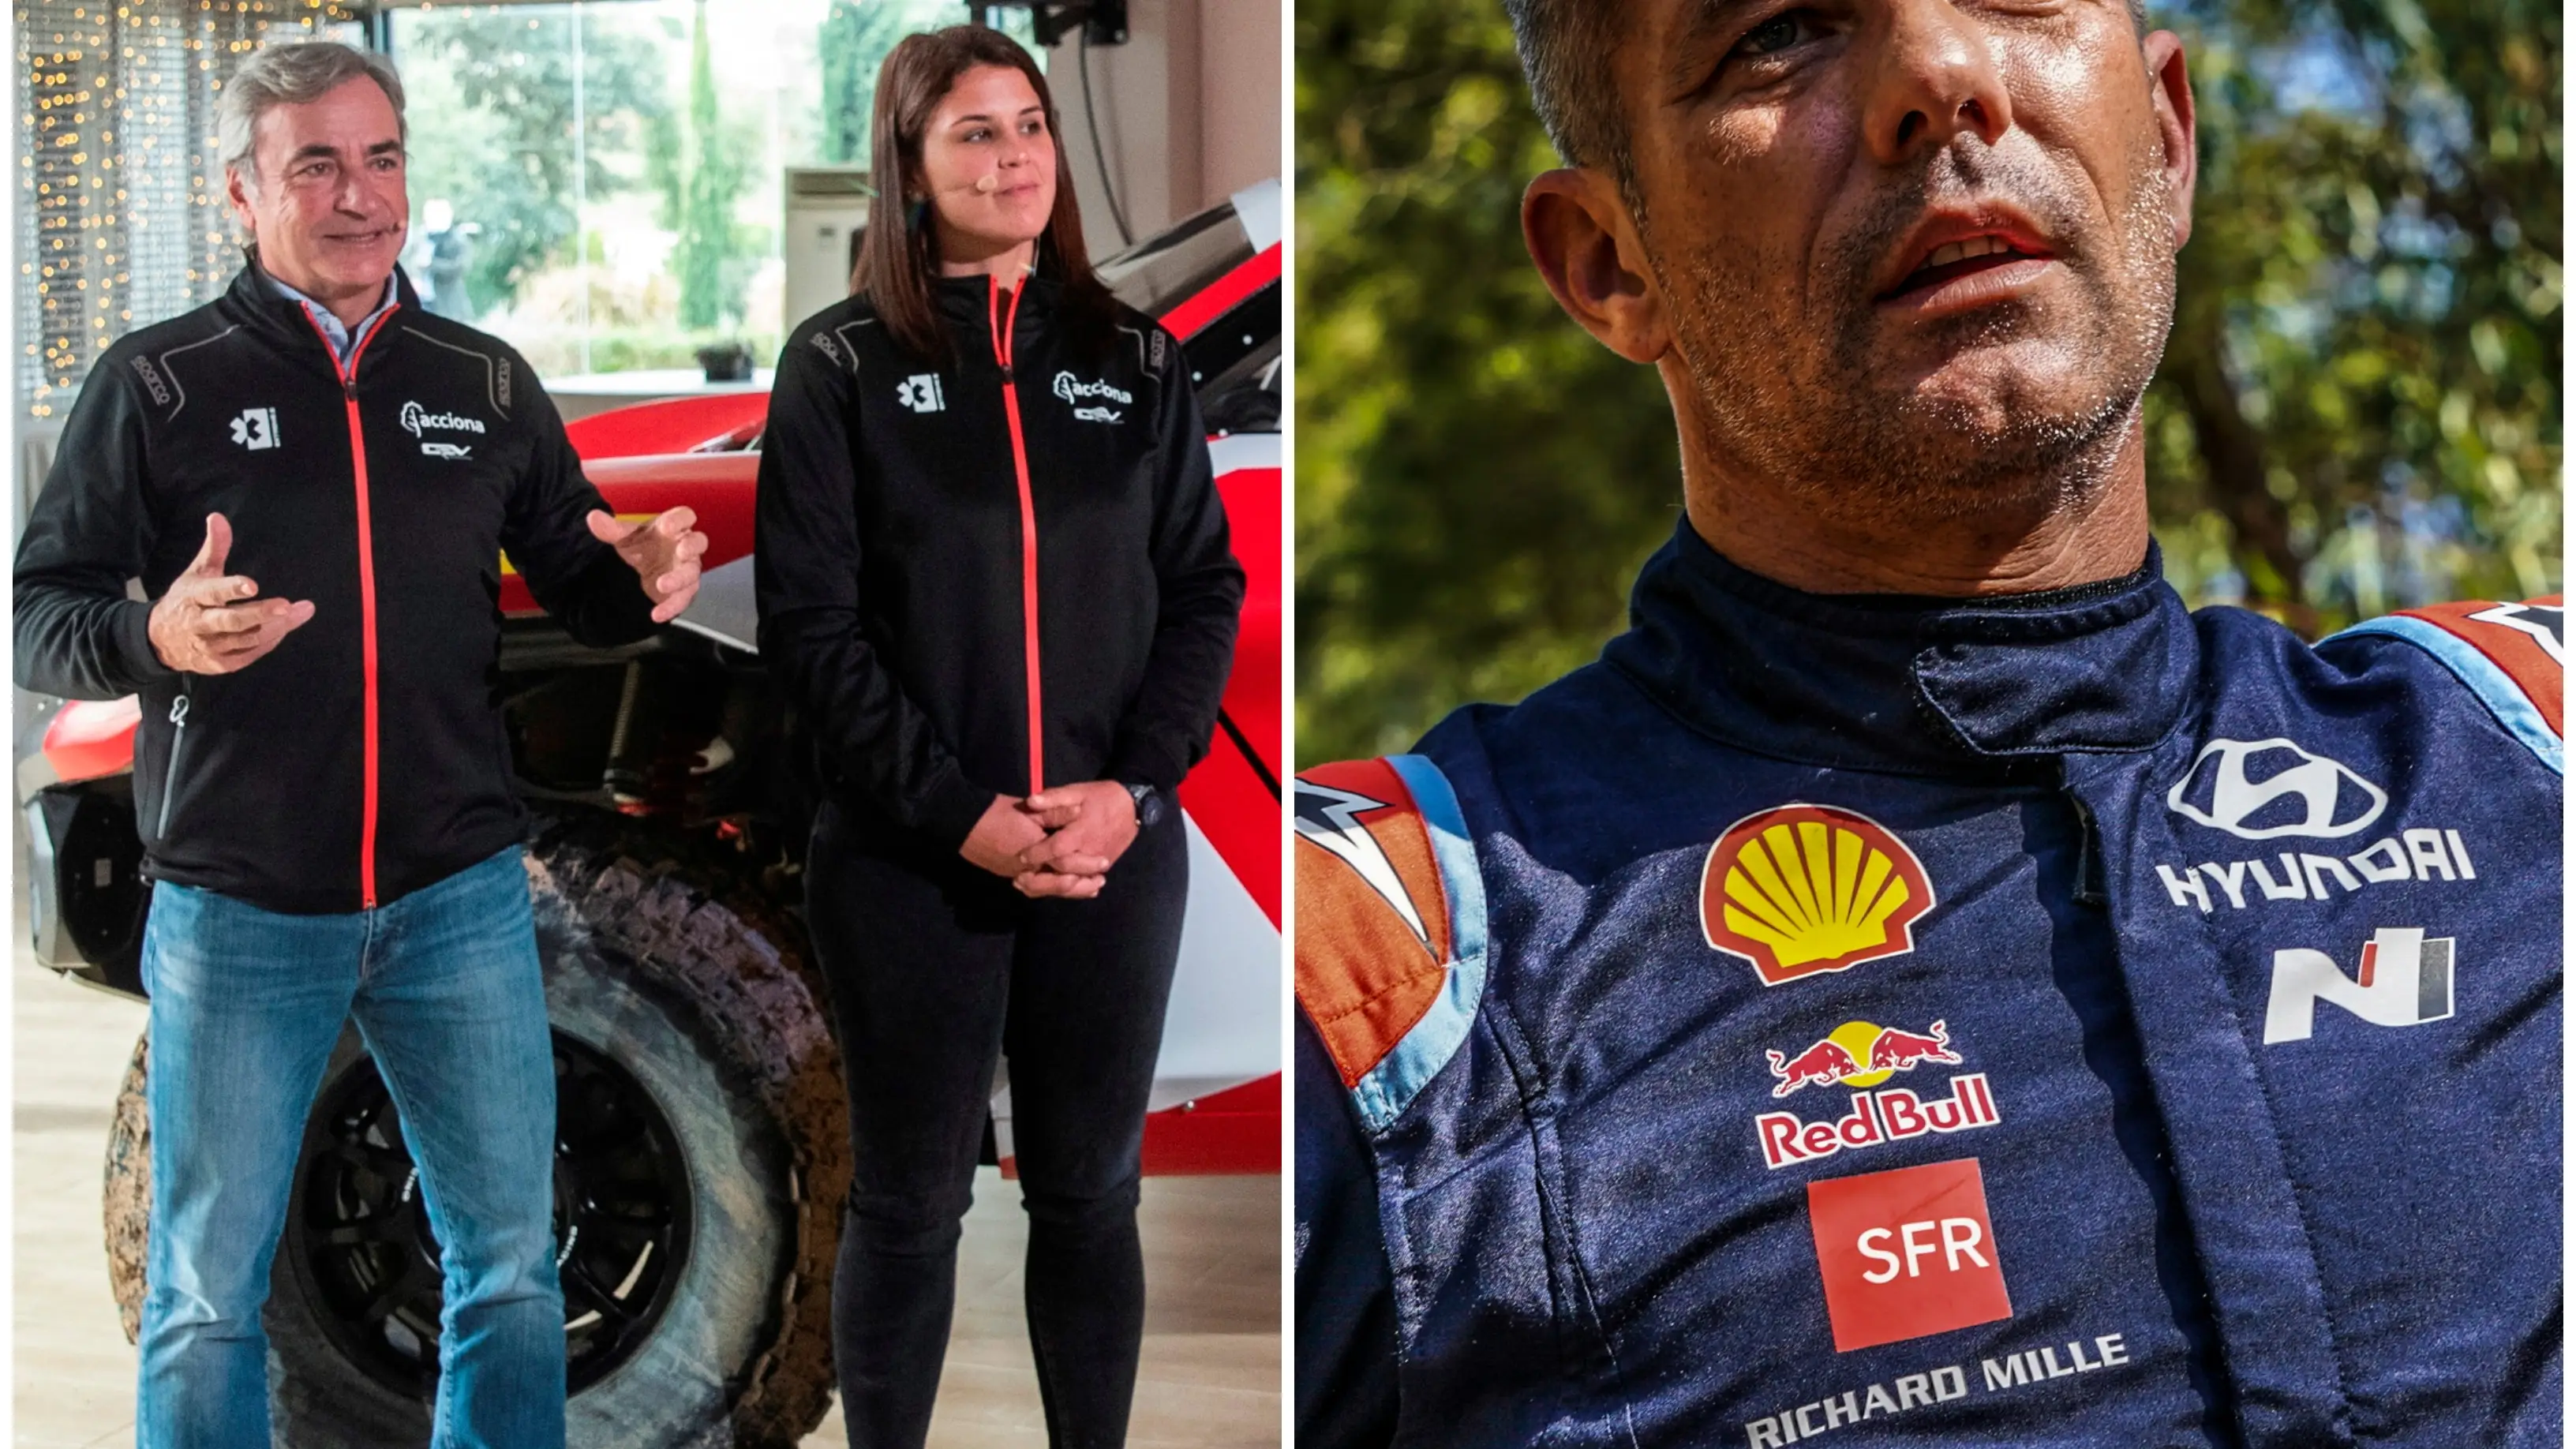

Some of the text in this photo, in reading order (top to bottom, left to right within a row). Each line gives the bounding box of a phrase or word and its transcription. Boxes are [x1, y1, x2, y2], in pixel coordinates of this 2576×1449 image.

[419, 411, 485, 434] acciona
[1072, 378, 1133, 404] acciona
[2155, 829, 2476, 913] HYUNDAI
[1759, 1075, 1998, 1166] Red Bull
[1856, 1216, 1990, 1284] SFR
[1745, 1333, 2129, 1449] RICHARD MILLE
